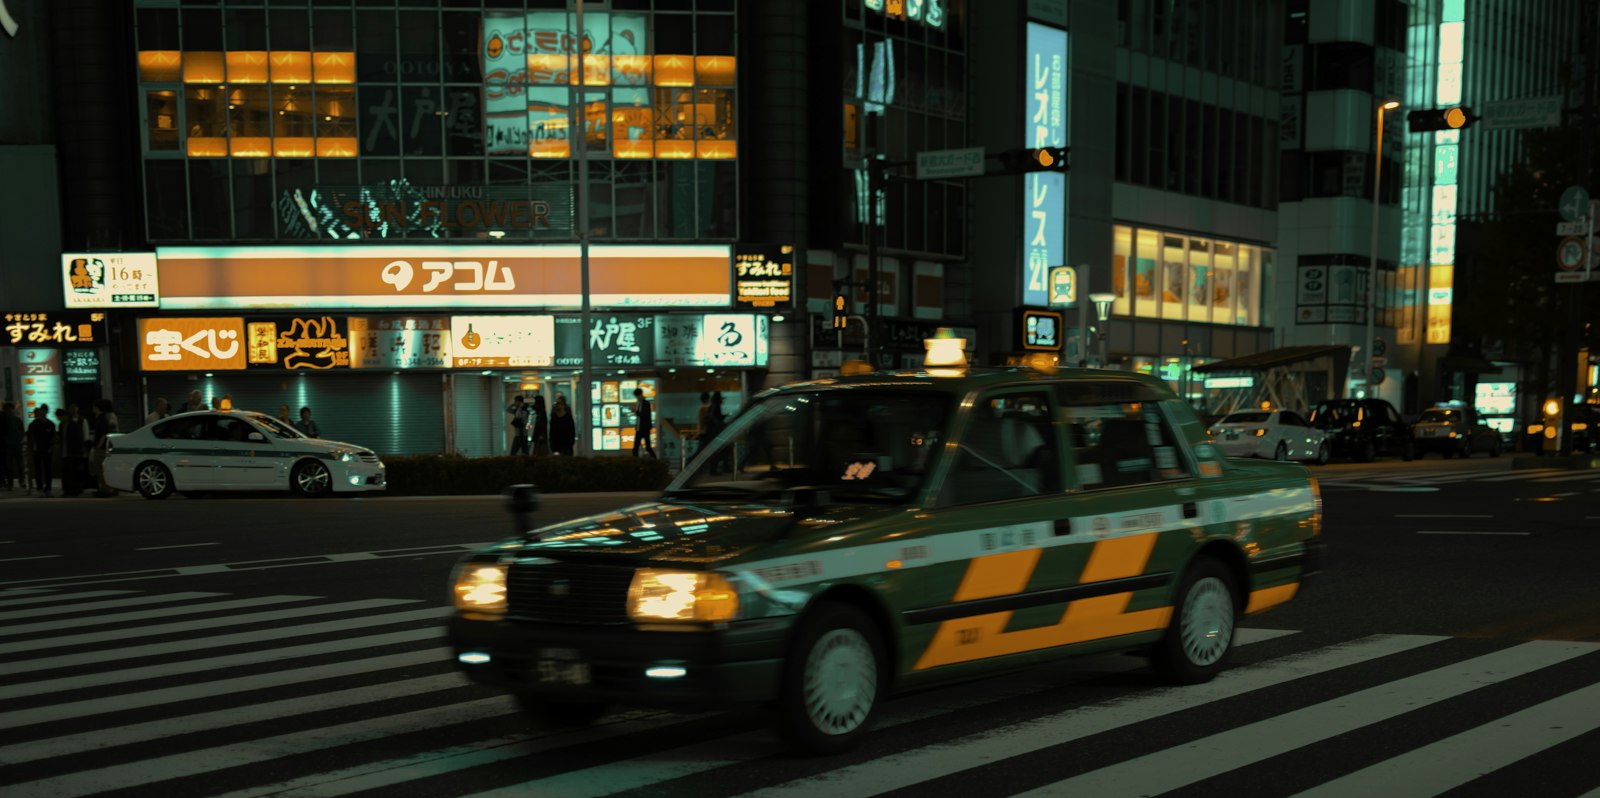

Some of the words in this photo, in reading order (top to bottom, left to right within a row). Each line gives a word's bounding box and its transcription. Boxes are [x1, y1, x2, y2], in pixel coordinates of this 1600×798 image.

[411, 185, 483, 199] SHINJUKU
[343, 201, 407, 228] SUN
[421, 199, 550, 228] FLOWER
[422, 260, 515, 293] アコム
[736, 260, 782, 277] すみれ
[5, 322, 77, 344] すみれ
[590, 317, 640, 352] 大戸屋
[637, 318, 652, 328] 3F
[145, 328, 239, 361] 宝くじ
